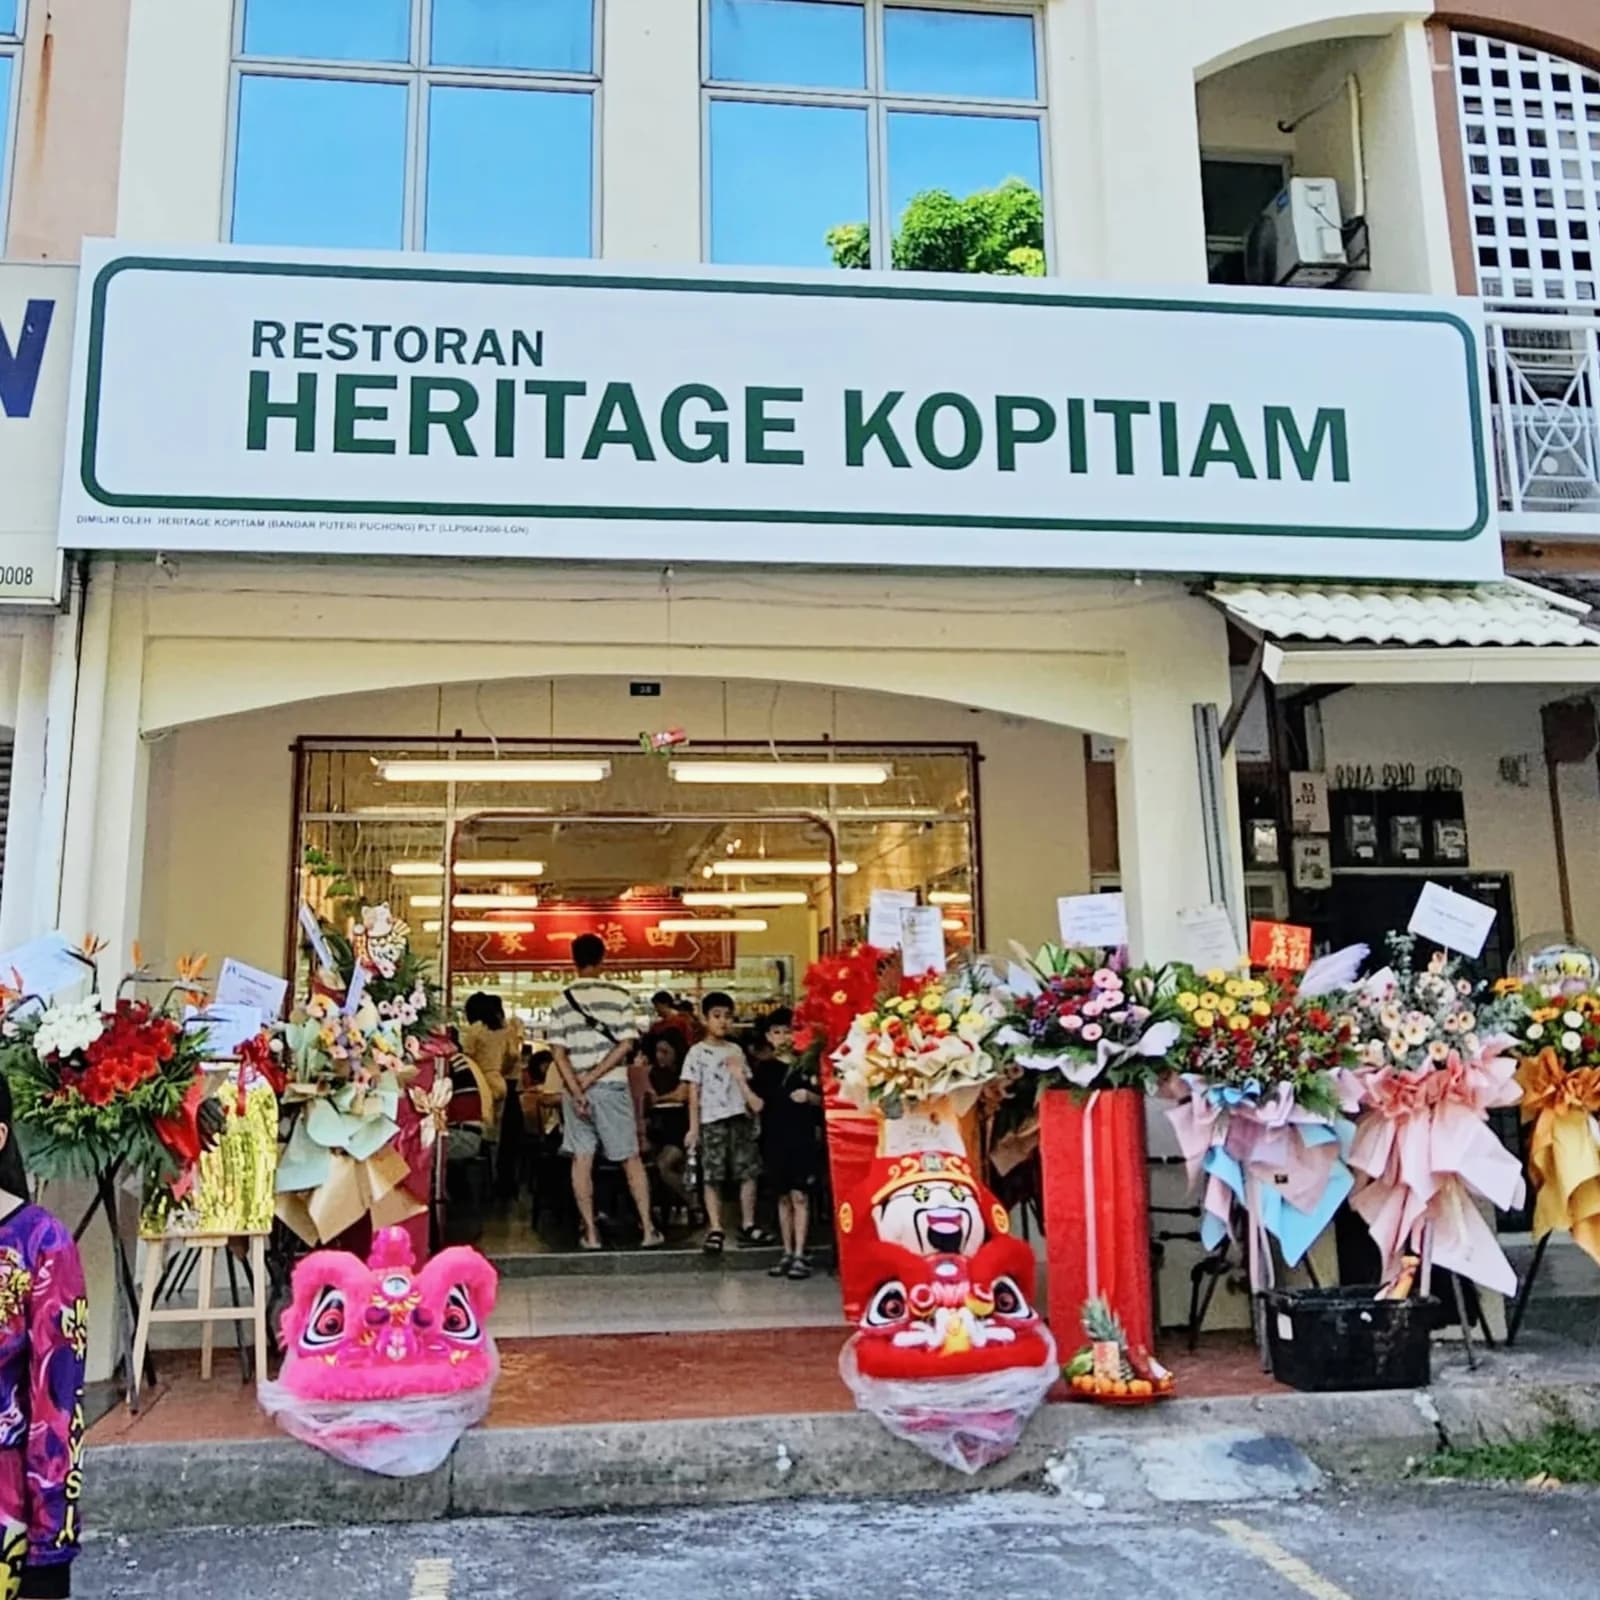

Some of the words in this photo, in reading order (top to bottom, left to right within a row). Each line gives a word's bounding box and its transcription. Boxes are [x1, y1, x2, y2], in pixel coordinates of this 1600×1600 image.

[252, 320, 543, 367] RESTORAN
[246, 370, 804, 465] HERITAGE
[844, 389, 1351, 482] KOPITIAM
[76, 514, 119, 525] DIMILIKI
[121, 515, 152, 525] OLEH
[157, 516, 211, 527] HERITAGE
[214, 517, 266, 528] KOPITIAM
[319, 519, 357, 530] PUTERI
[418, 521, 436, 532] PLT
